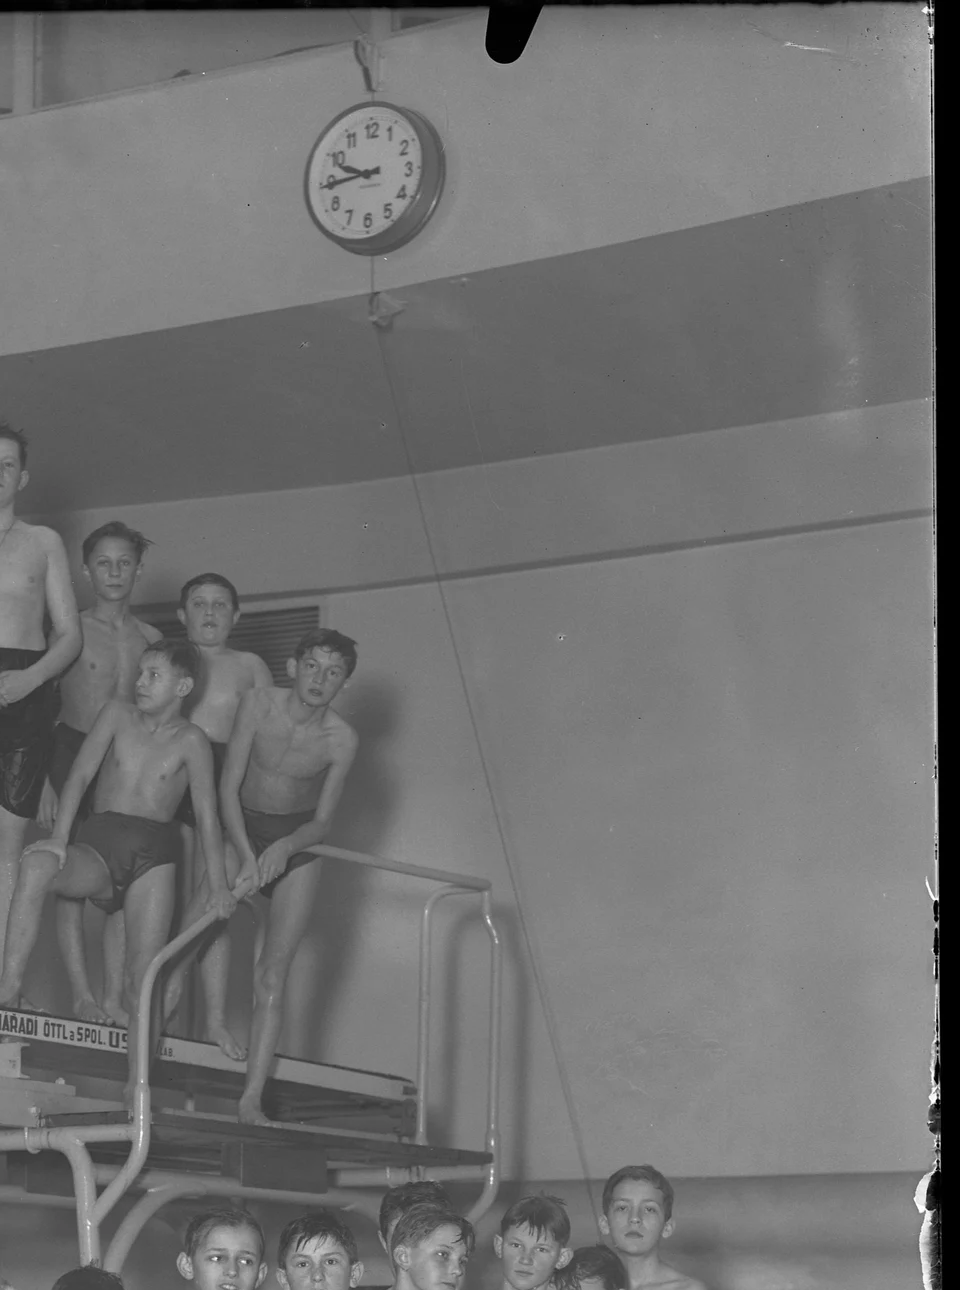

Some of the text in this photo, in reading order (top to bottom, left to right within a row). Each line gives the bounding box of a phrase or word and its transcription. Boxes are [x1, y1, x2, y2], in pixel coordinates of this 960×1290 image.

[364, 122, 379, 139] 12
[386, 125, 393, 141] 1
[346, 132, 357, 149] 11
[399, 139, 409, 156] 2
[330, 150, 346, 168] 10
[404, 161, 413, 178] 3
[395, 184, 407, 200] 4
[331, 195, 341, 211] 8
[383, 203, 393, 219] 5
[344, 209, 354, 226] 7
[363, 212, 373, 229] 6
[69, 1030, 75, 1041] a
[77, 1026, 106, 1045] SPOL.
